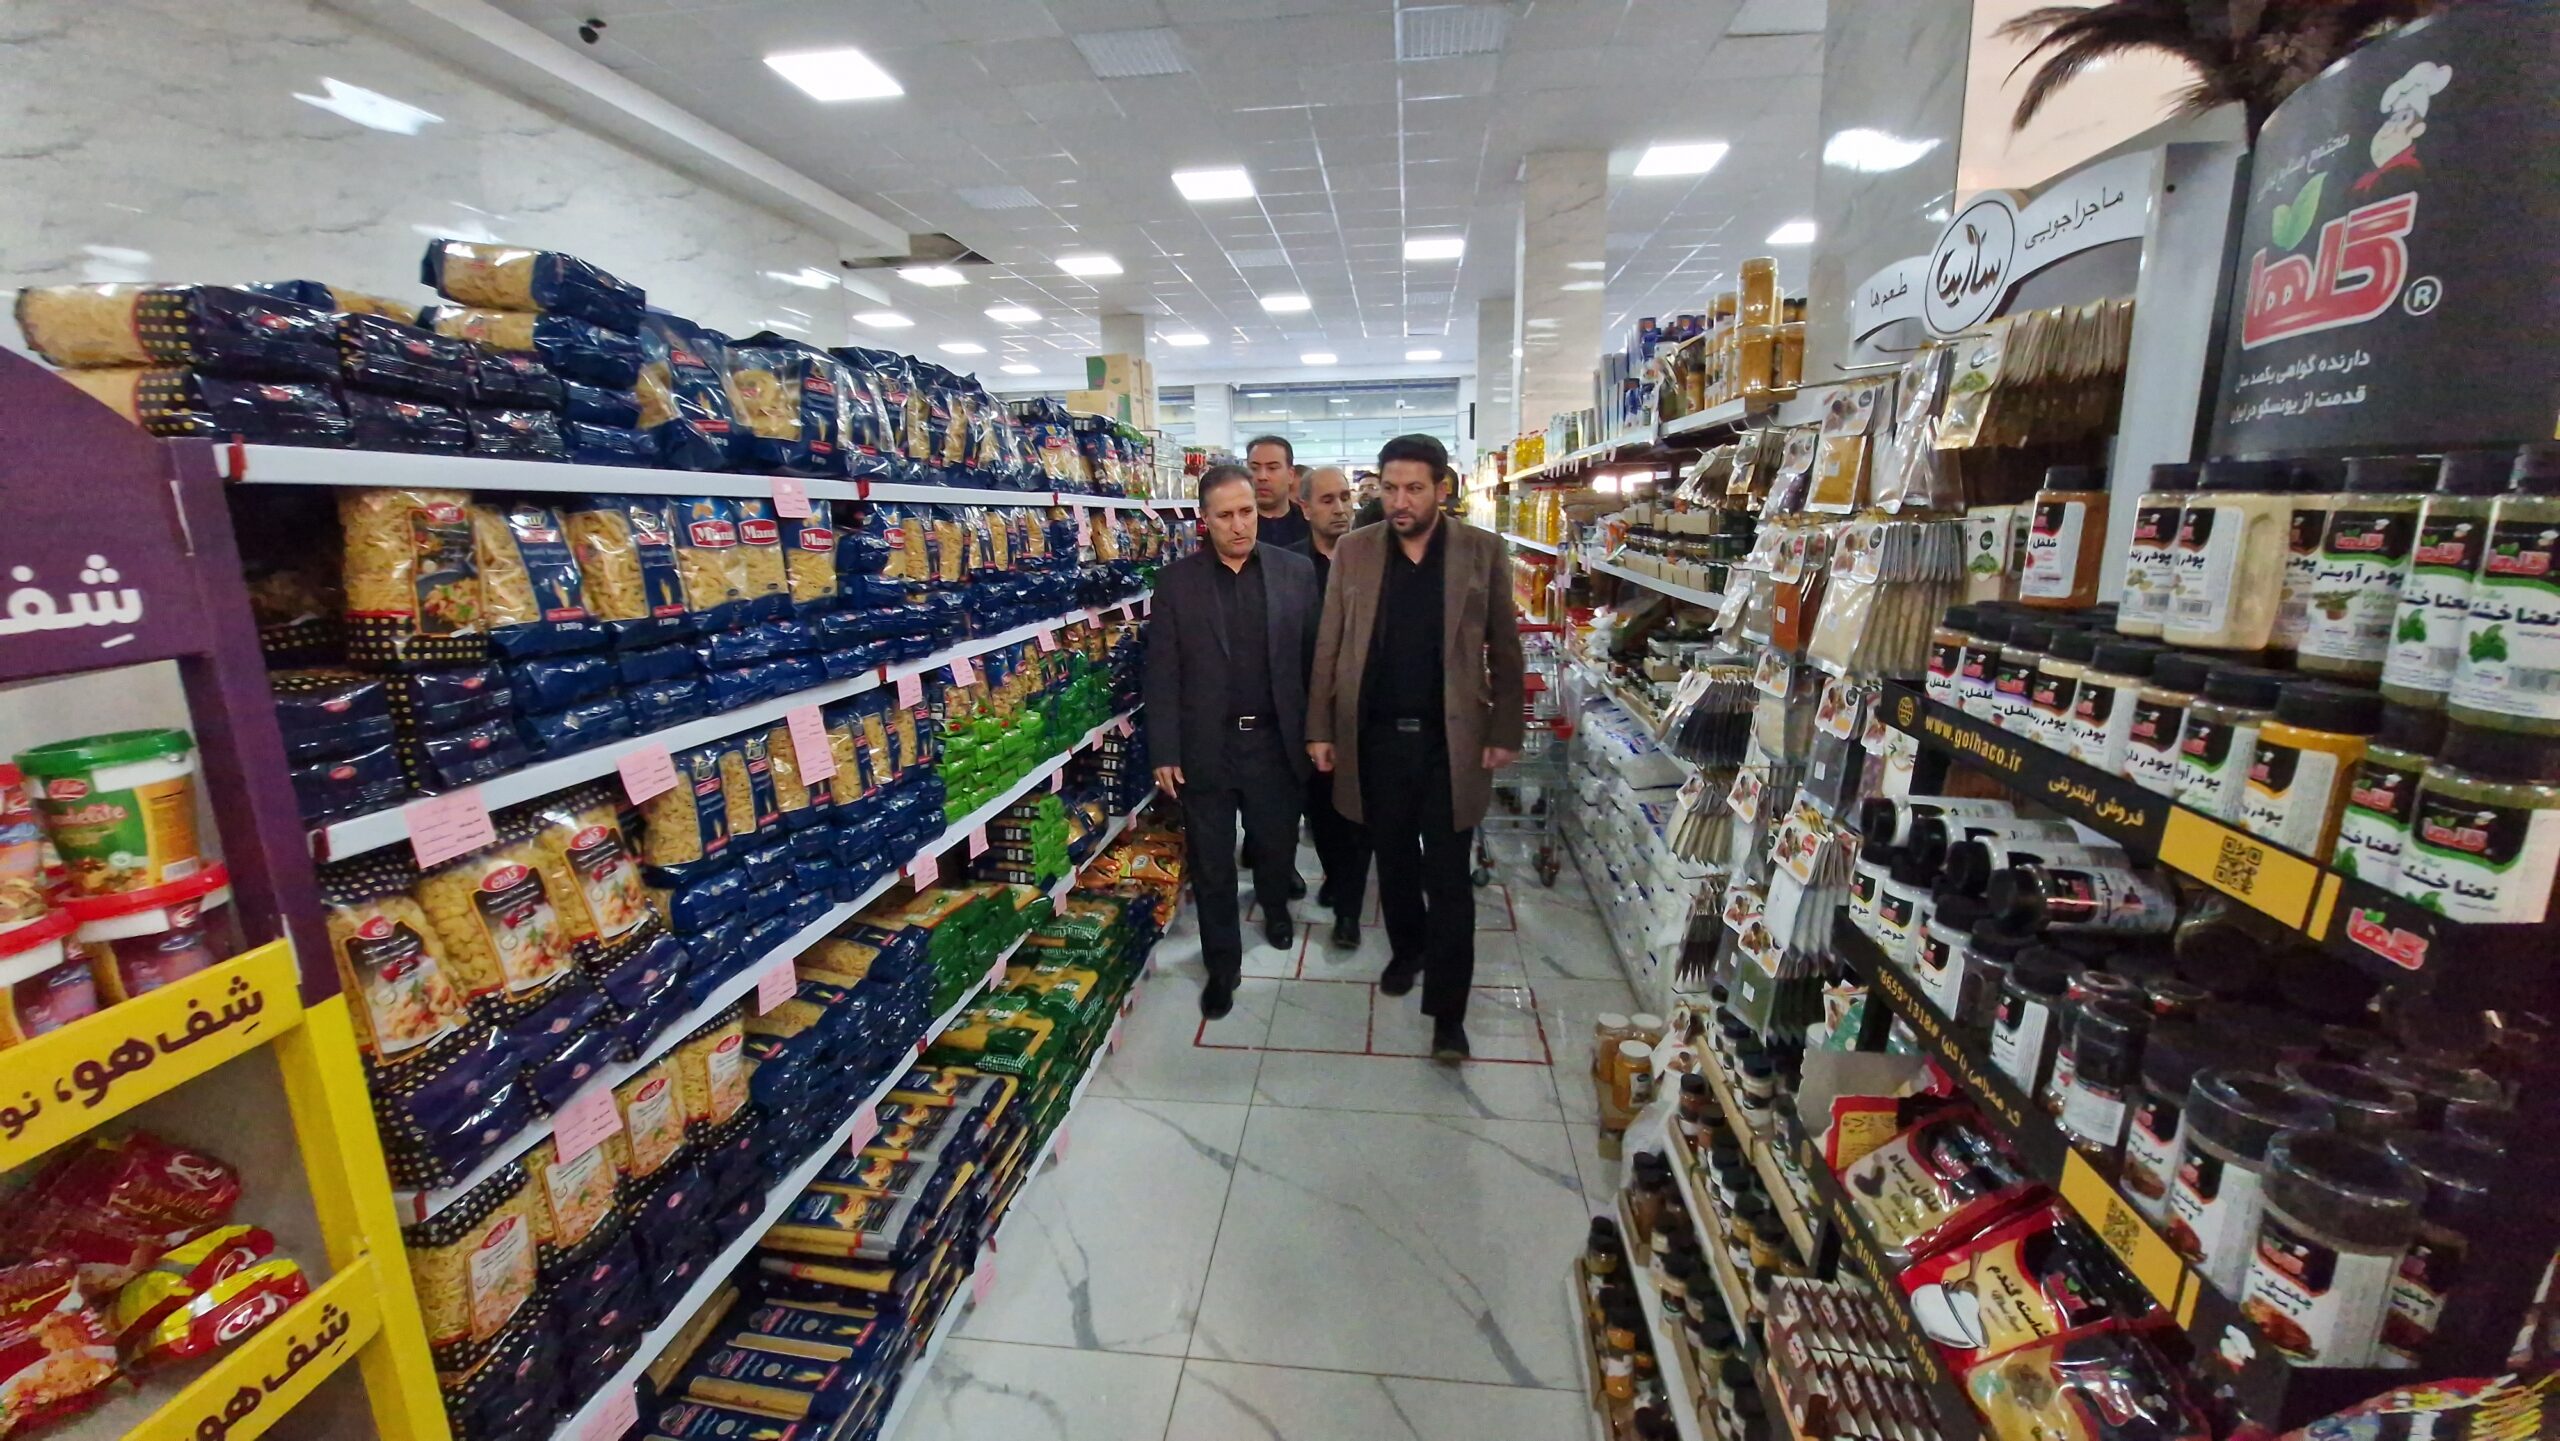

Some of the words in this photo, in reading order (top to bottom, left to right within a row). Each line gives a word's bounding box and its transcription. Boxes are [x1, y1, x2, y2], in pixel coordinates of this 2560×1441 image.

[2024, 186, 2124, 250] ماجراجویی
[2276, 353, 2318, 384] گواهی
[2317, 349, 2371, 374] دارنده
[2299, 391, 2314, 415] از
[2315, 384, 2368, 409] قدمت
[2032, 538, 2058, 550] فلفل
[1924, 714, 2023, 773] www.golhaco.ir
[2047, 775, 2098, 807] اینترنتی
[2095, 796, 2145, 827] فروش
[2453, 878, 2499, 901] نعنا
[1985, 1264, 2024, 1298] گندم
